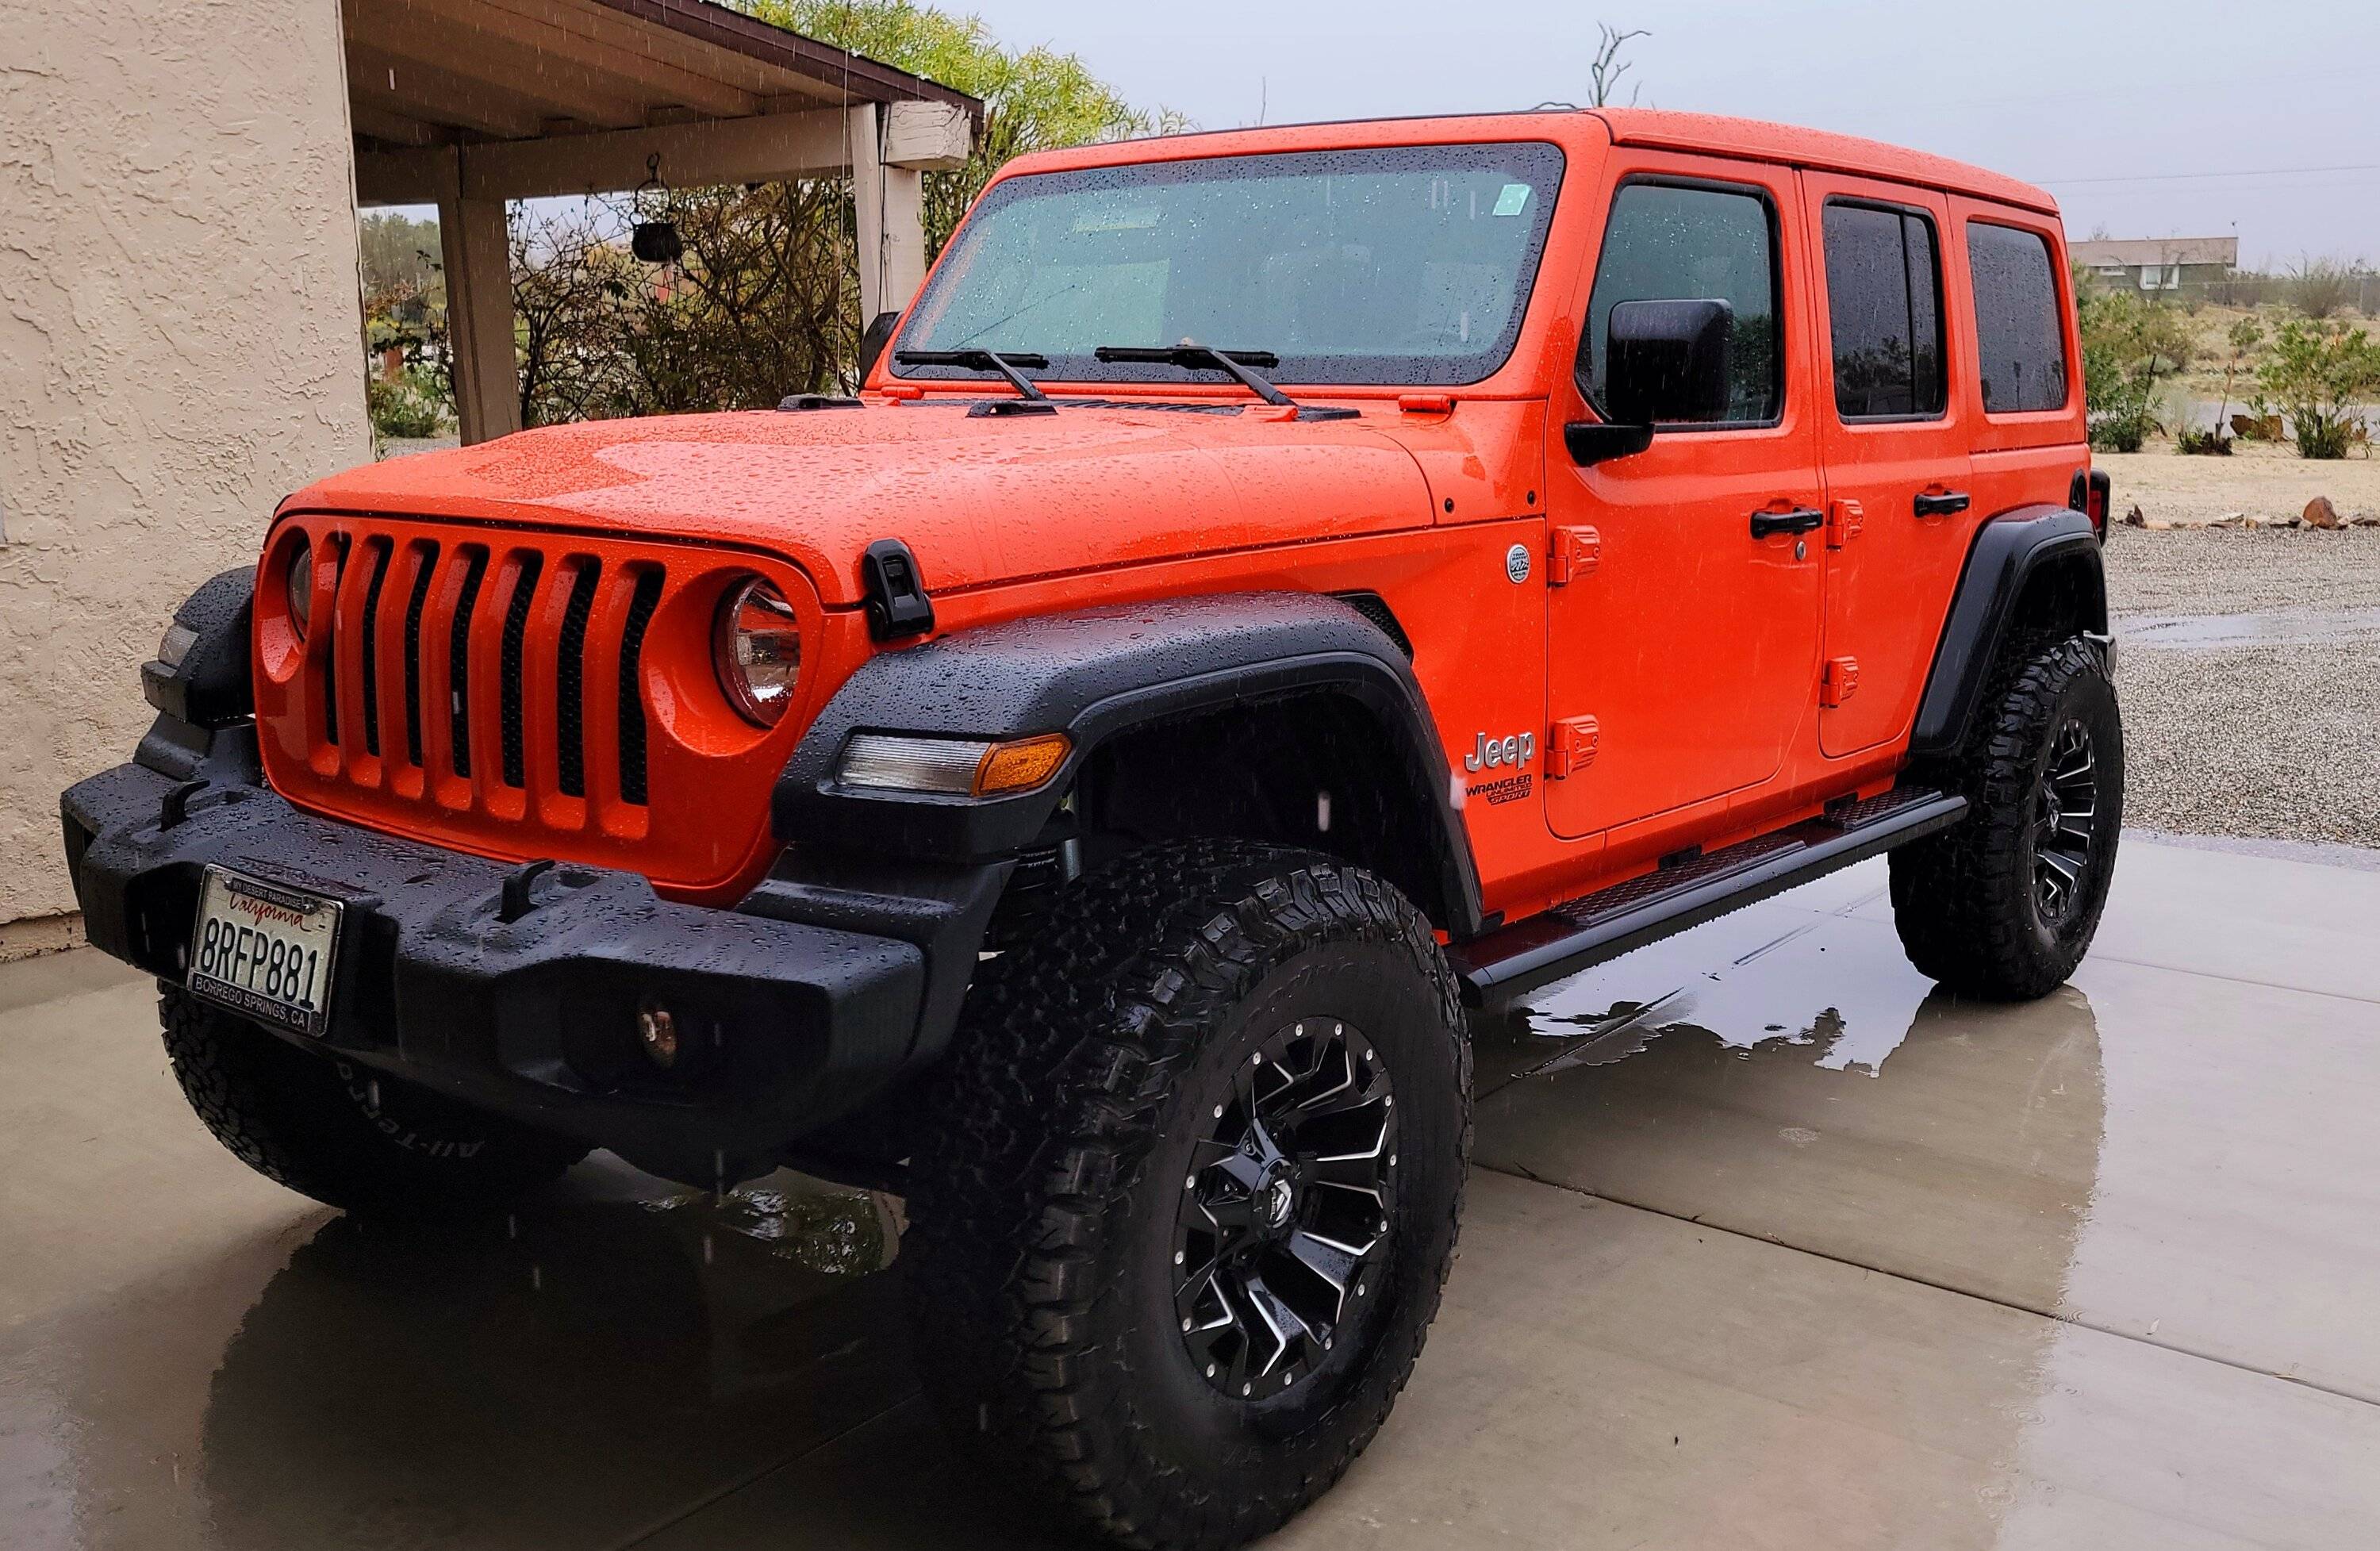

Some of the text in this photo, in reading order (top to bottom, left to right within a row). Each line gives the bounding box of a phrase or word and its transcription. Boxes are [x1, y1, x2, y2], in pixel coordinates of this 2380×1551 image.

[1464, 731, 1536, 774] Jeep
[1465, 774, 1532, 797] WRANGLER
[1486, 782, 1533, 797] UNLIMITED
[229, 893, 312, 932] California
[243, 882, 268, 899] DESERT
[268, 891, 301, 909] PARADISE
[200, 917, 318, 1011] 8RFP881
[195, 976, 305, 1027] BORREGO SPRINGS, CA
